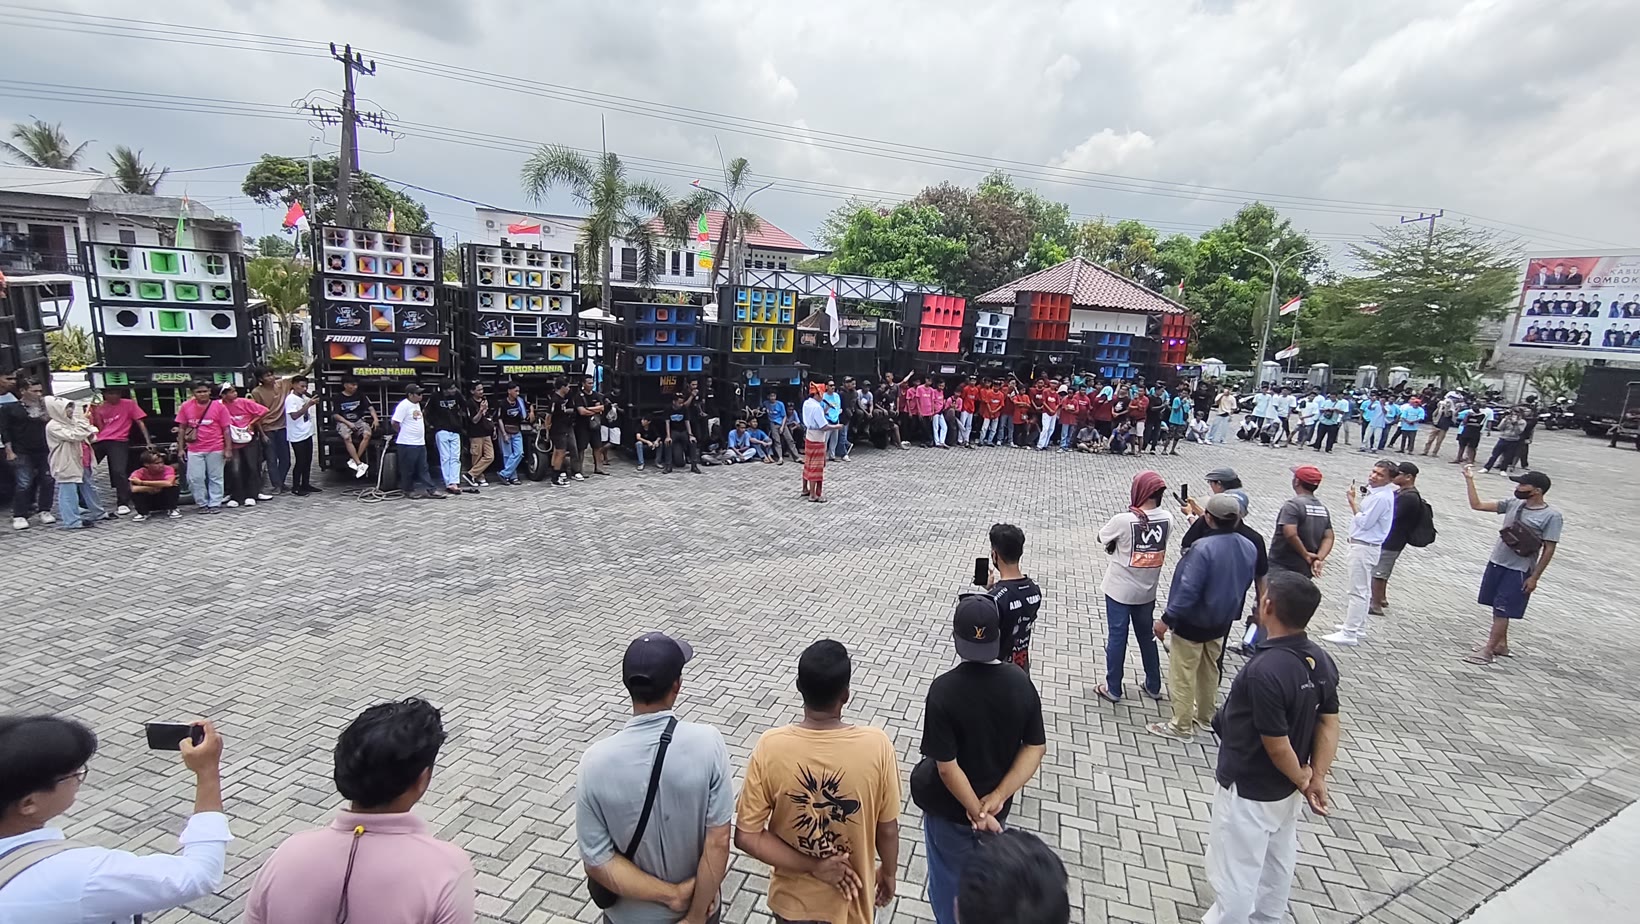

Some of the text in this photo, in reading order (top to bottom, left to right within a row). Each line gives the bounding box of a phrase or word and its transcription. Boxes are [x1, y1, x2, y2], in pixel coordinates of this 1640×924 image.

[1587, 276, 1639, 284] LOMBOK
[325, 335, 441, 346] FAMOR MANIA
[353, 367, 416, 376] FAMOR MANIA
[503, 365, 564, 373] FAMOR MANIA
[797, 829, 842, 851] EVERY
